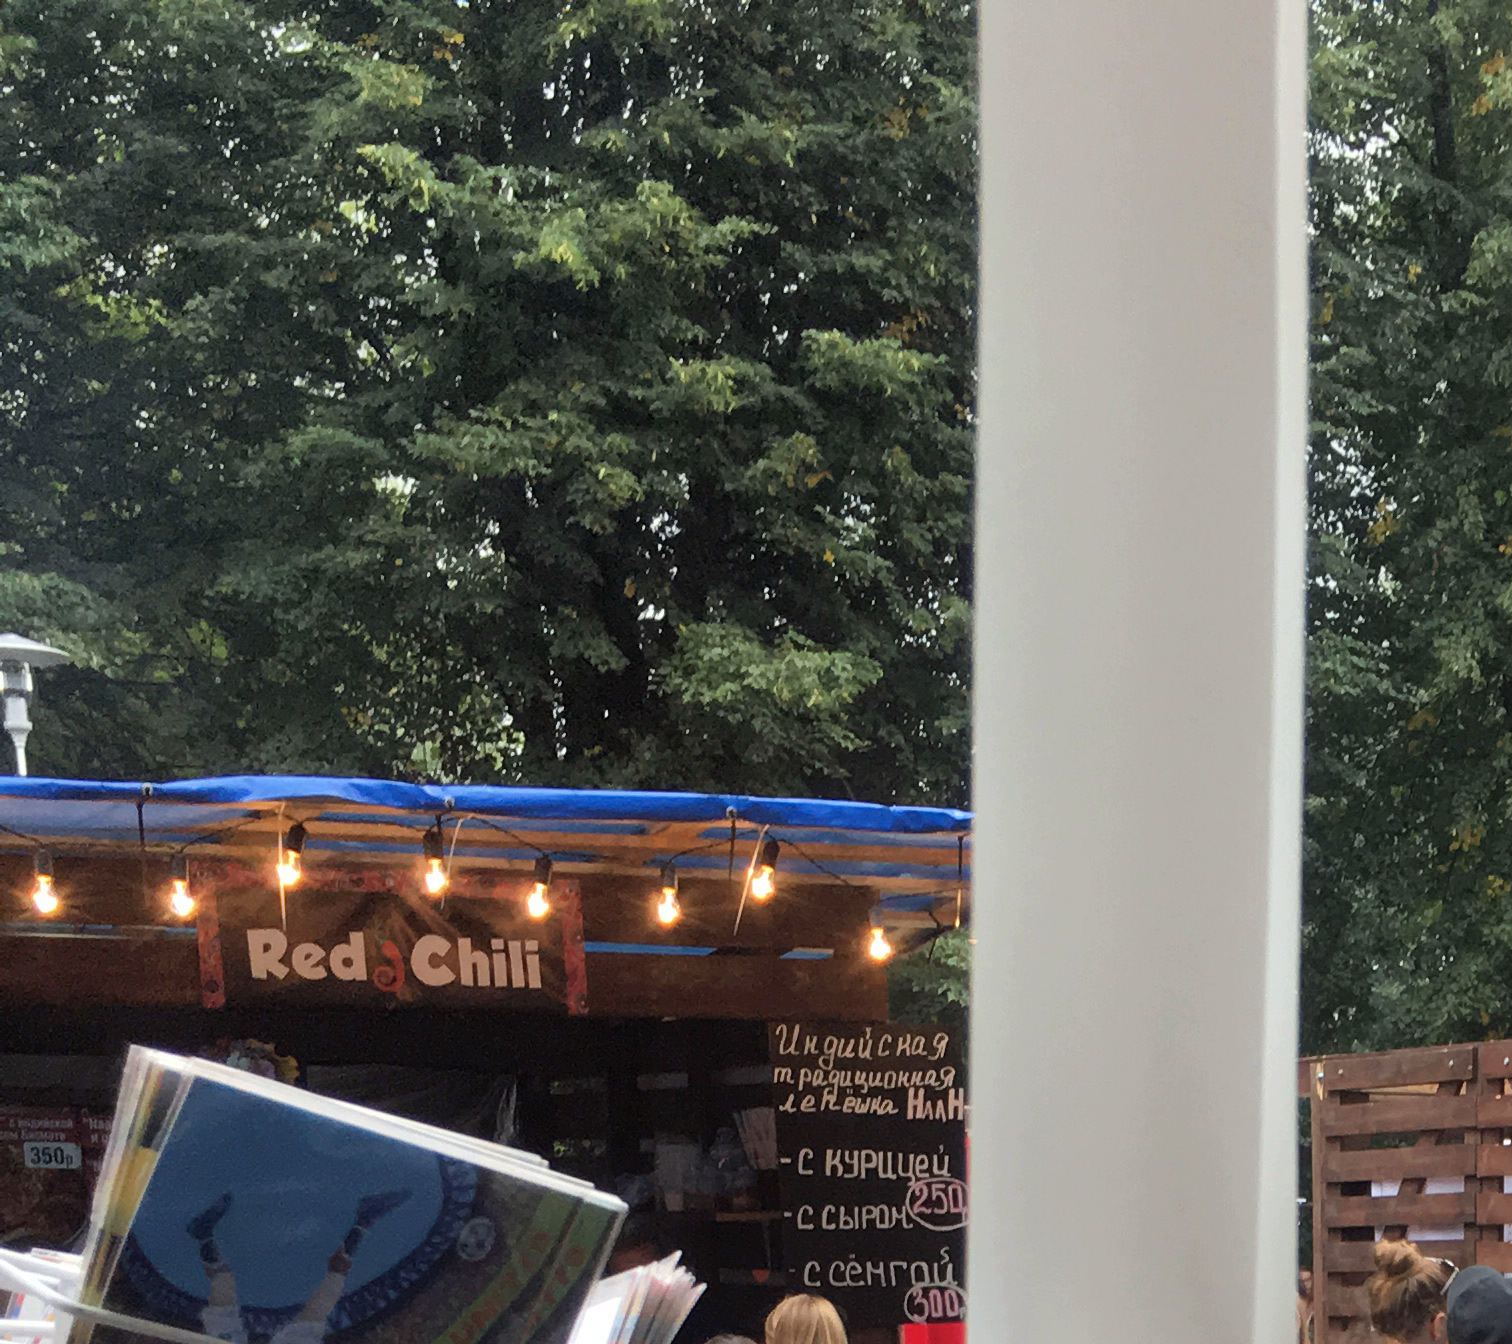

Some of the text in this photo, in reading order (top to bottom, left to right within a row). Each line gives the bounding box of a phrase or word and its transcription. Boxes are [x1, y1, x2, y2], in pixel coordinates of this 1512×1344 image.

[247, 928, 542, 988] Red Chili
[776, 1024, 949, 1069] Индийская
[774, 1066, 955, 1093] традиционная
